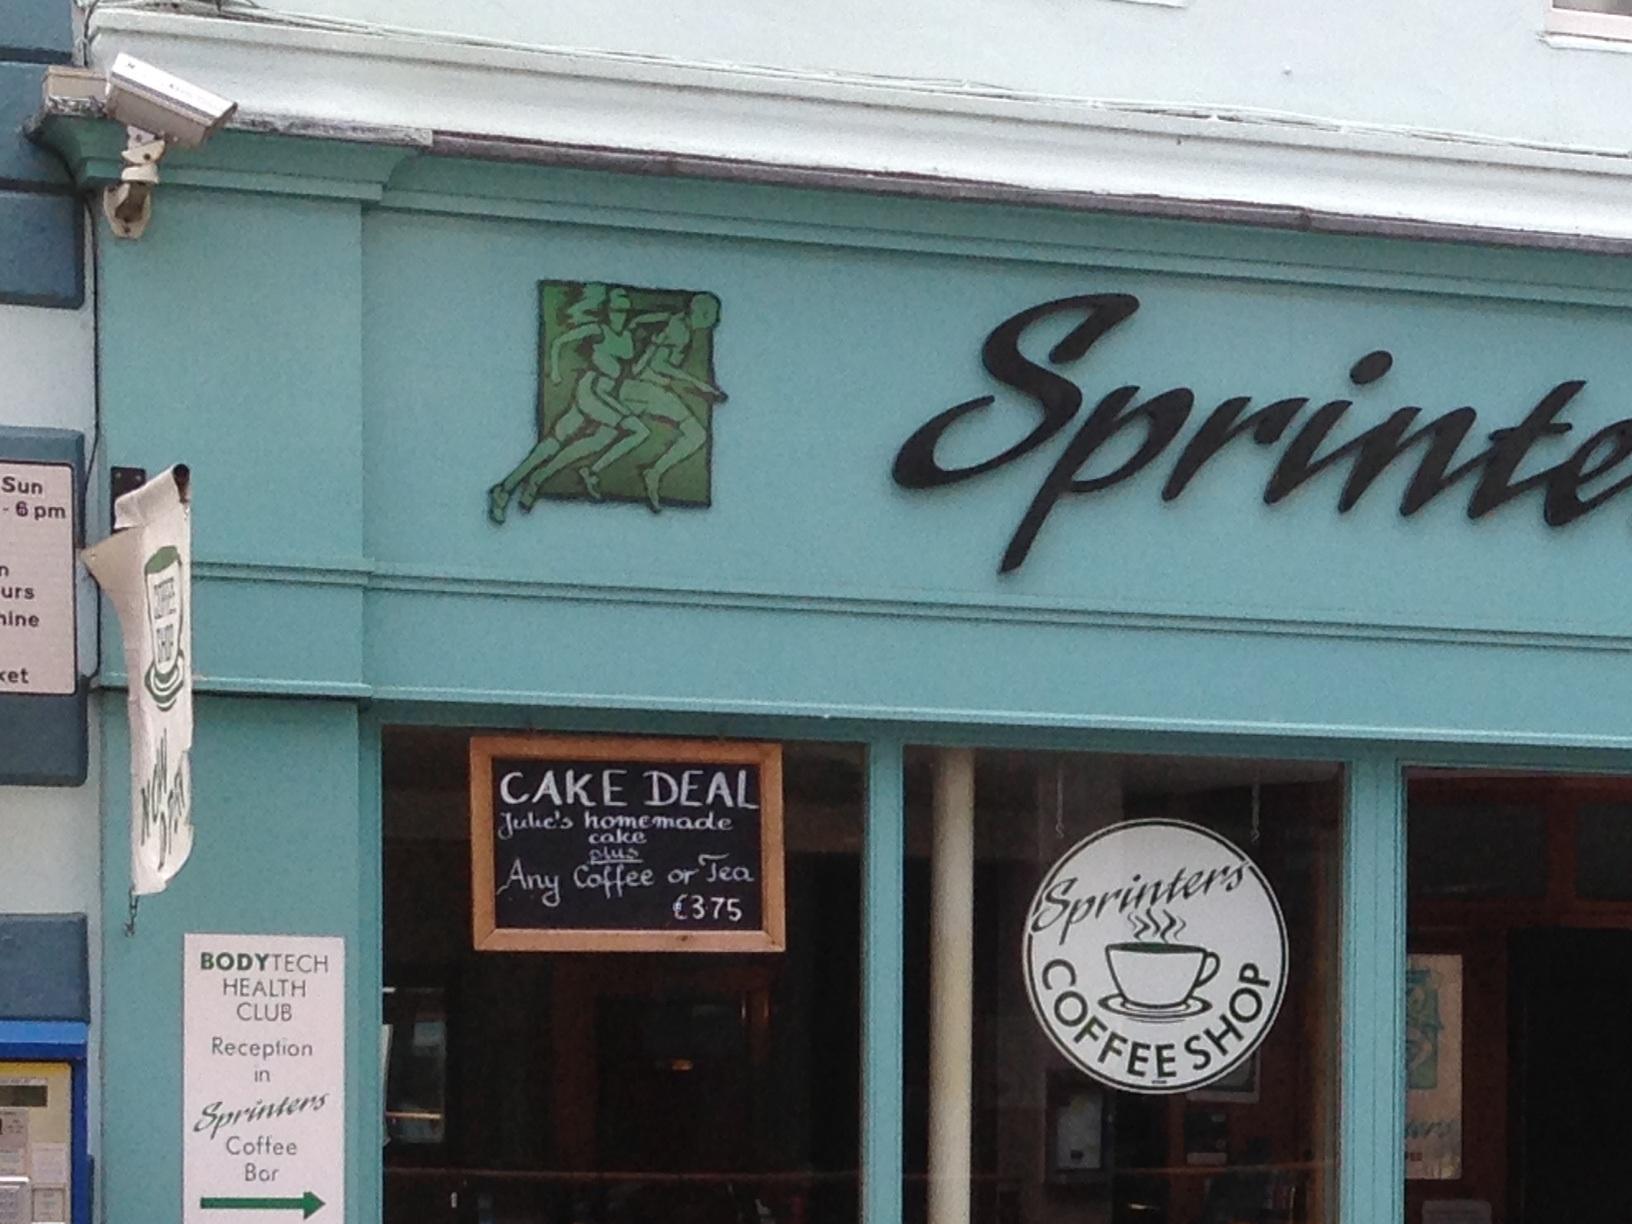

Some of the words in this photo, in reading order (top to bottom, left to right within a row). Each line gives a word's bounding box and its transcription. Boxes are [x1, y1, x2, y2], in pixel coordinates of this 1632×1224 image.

[2, 476, 43, 495] Sun
[15, 501, 28, 517] 6
[34, 504, 66, 519] pm
[499, 768, 628, 807] CAKE
[642, 768, 760, 810] DEAL
[584, 811, 734, 832] homemade
[588, 829, 648, 845] cake
[496, 858, 562, 908] Any
[573, 863, 655, 899] Coffee
[667, 868, 701, 885] or
[697, 853, 755, 883] Tea
[1031, 860, 1251, 946] Sprinters
[199, 951, 329, 974] BODYTECH
[222, 978, 307, 998] HEALTH
[236, 1002, 293, 1022] CLUB
[1042, 958, 1178, 1079] COFFEE
[1183, 962, 1271, 1071] SHOP
[211, 1035, 314, 1058] Reception
[253, 1065, 271, 1084] in
[193, 1092, 329, 1141] Sprinters
[225, 1135, 299, 1157] Coffee
[243, 1162, 280, 1183] Bar
